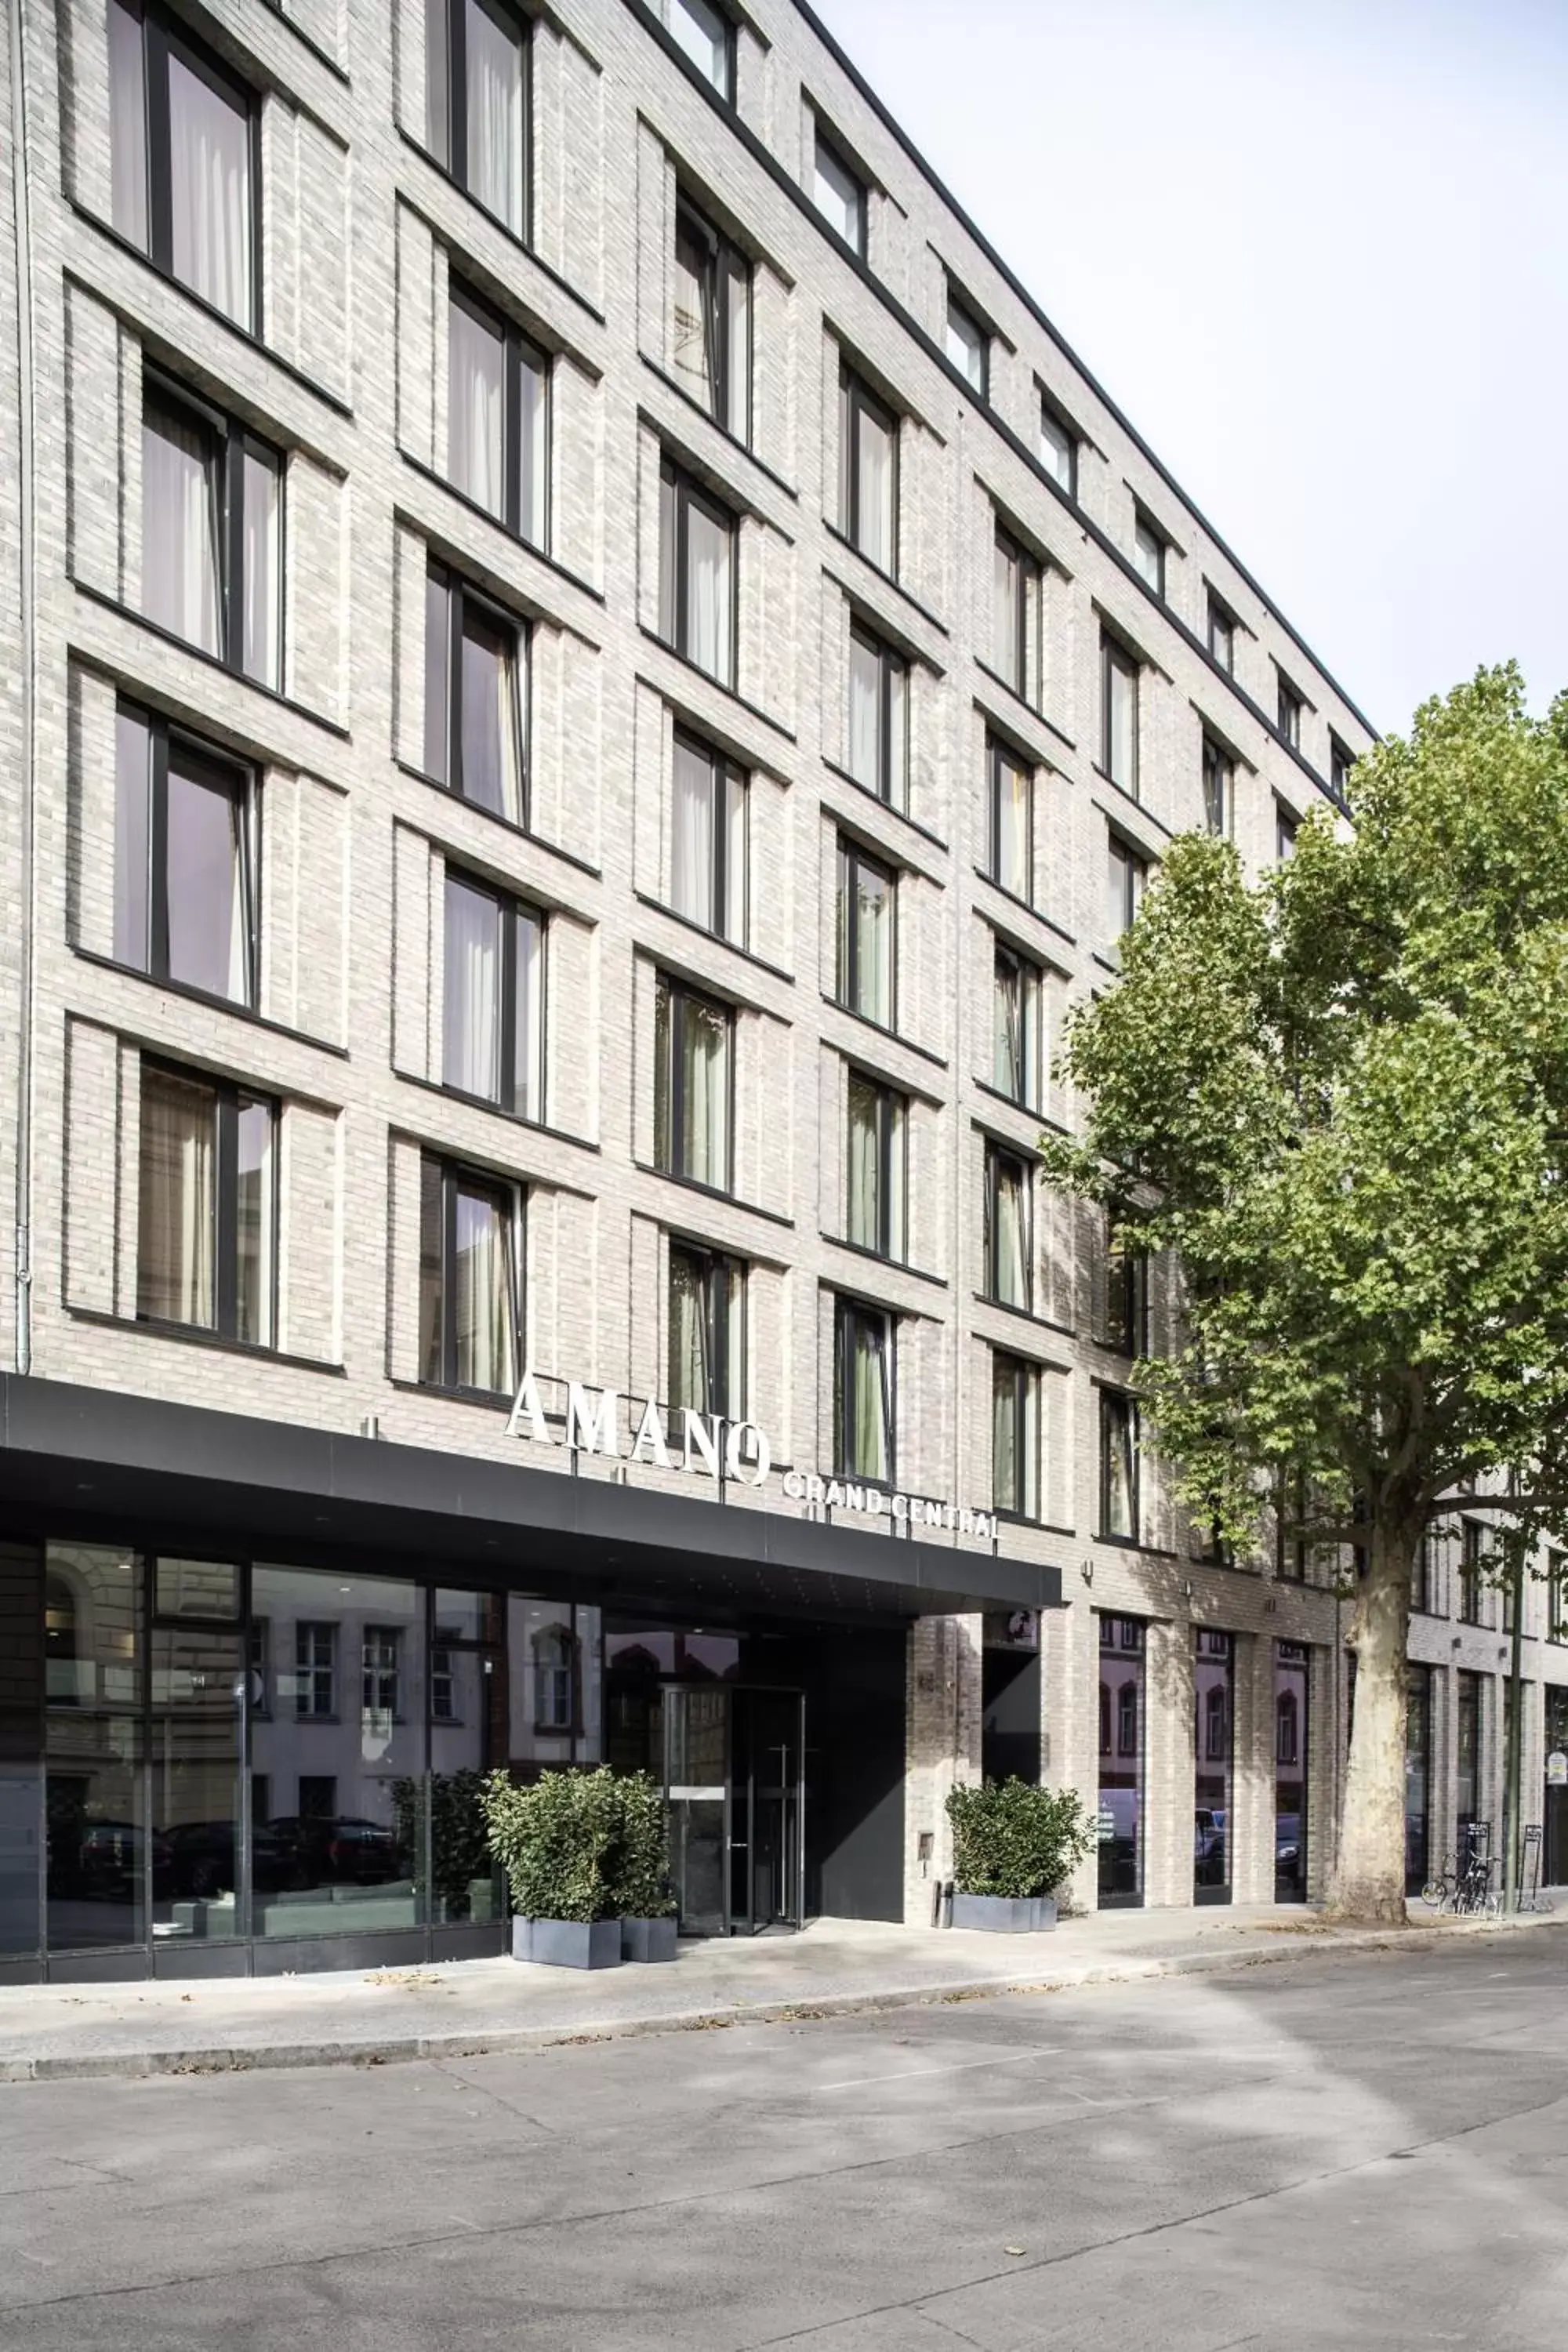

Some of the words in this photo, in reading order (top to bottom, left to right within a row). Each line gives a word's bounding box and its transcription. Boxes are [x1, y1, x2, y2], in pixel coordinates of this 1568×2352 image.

[503, 1369, 771, 1486] AMANO
[784, 1472, 882, 1514] GRAND
[891, 1494, 1000, 1539] CENTRAL
